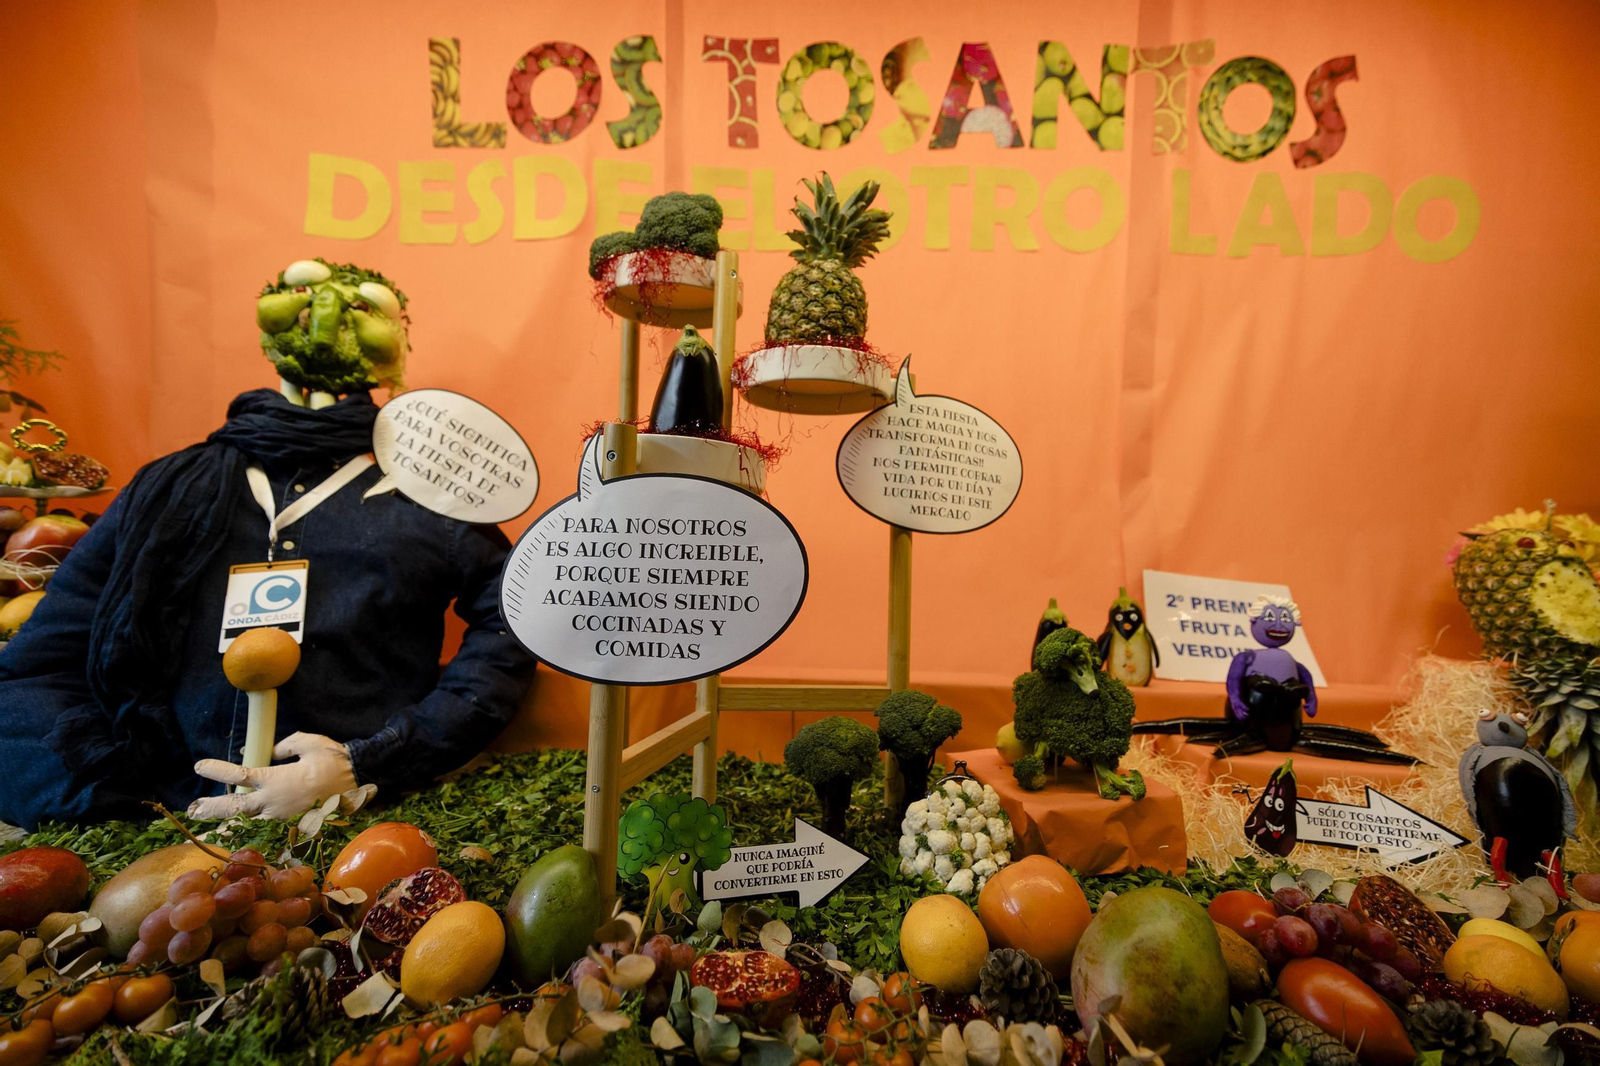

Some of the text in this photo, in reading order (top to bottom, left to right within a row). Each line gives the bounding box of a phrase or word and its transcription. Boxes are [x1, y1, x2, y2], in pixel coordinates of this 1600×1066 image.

[428, 35, 1360, 169] LOS TOSANTOS
[303, 152, 1481, 264] DESDE EL OTRO LADO
[909, 404, 978, 426] ESTA FIESTA
[407, 400, 528, 472] ¿QUÉ SIGNIFICA
[887, 416, 997, 443] HACE MAGIA Y NOS
[394, 410, 524, 489] PARA VOSOTRAS
[867, 428, 1008, 459] TRANSFORMA EN COSAS
[395, 432, 500, 496] LA FIESTA DE
[899, 445, 985, 467] FANTÁSTICAS!!
[392, 452, 485, 508] TOSANTOS?
[873, 457, 1002, 484] NOS PERMITE COBRAR
[883, 472, 993, 496] VIDA POR UN DÍA Y
[884, 487, 992, 510] LUCIRNOS EN ESTE
[909, 505, 971, 521] MERCADO
[563, 518, 747, 537] PARA NOSOTROS
[545, 541, 764, 565] ES ALGO INCREIBLE,
[554, 565, 749, 587] PORQUE SIEMPRE
[542, 589, 760, 613] ACABAMOS SIENDO
[1191, 597, 1252, 614] PREM
[228, 617, 261, 625] ONDA
[572, 614, 726, 636] COCINADAS Y
[1180, 620, 1247, 637] FRUTA
[595, 639, 701, 660] COMIDAS
[1318, 806, 1421, 829] SÓLO TOSANTOS
[1307, 817, 1442, 842] PUEDE CONVERTIRME
[1323, 829, 1336, 838] EN
[1339, 830, 1372, 843] TODO
[734, 842, 825, 862] NUNCA IMAGINÉ
[746, 857, 814, 875] QUE PODRÍA
[714, 869, 844, 890] CONVERTIRME EN ESTO
